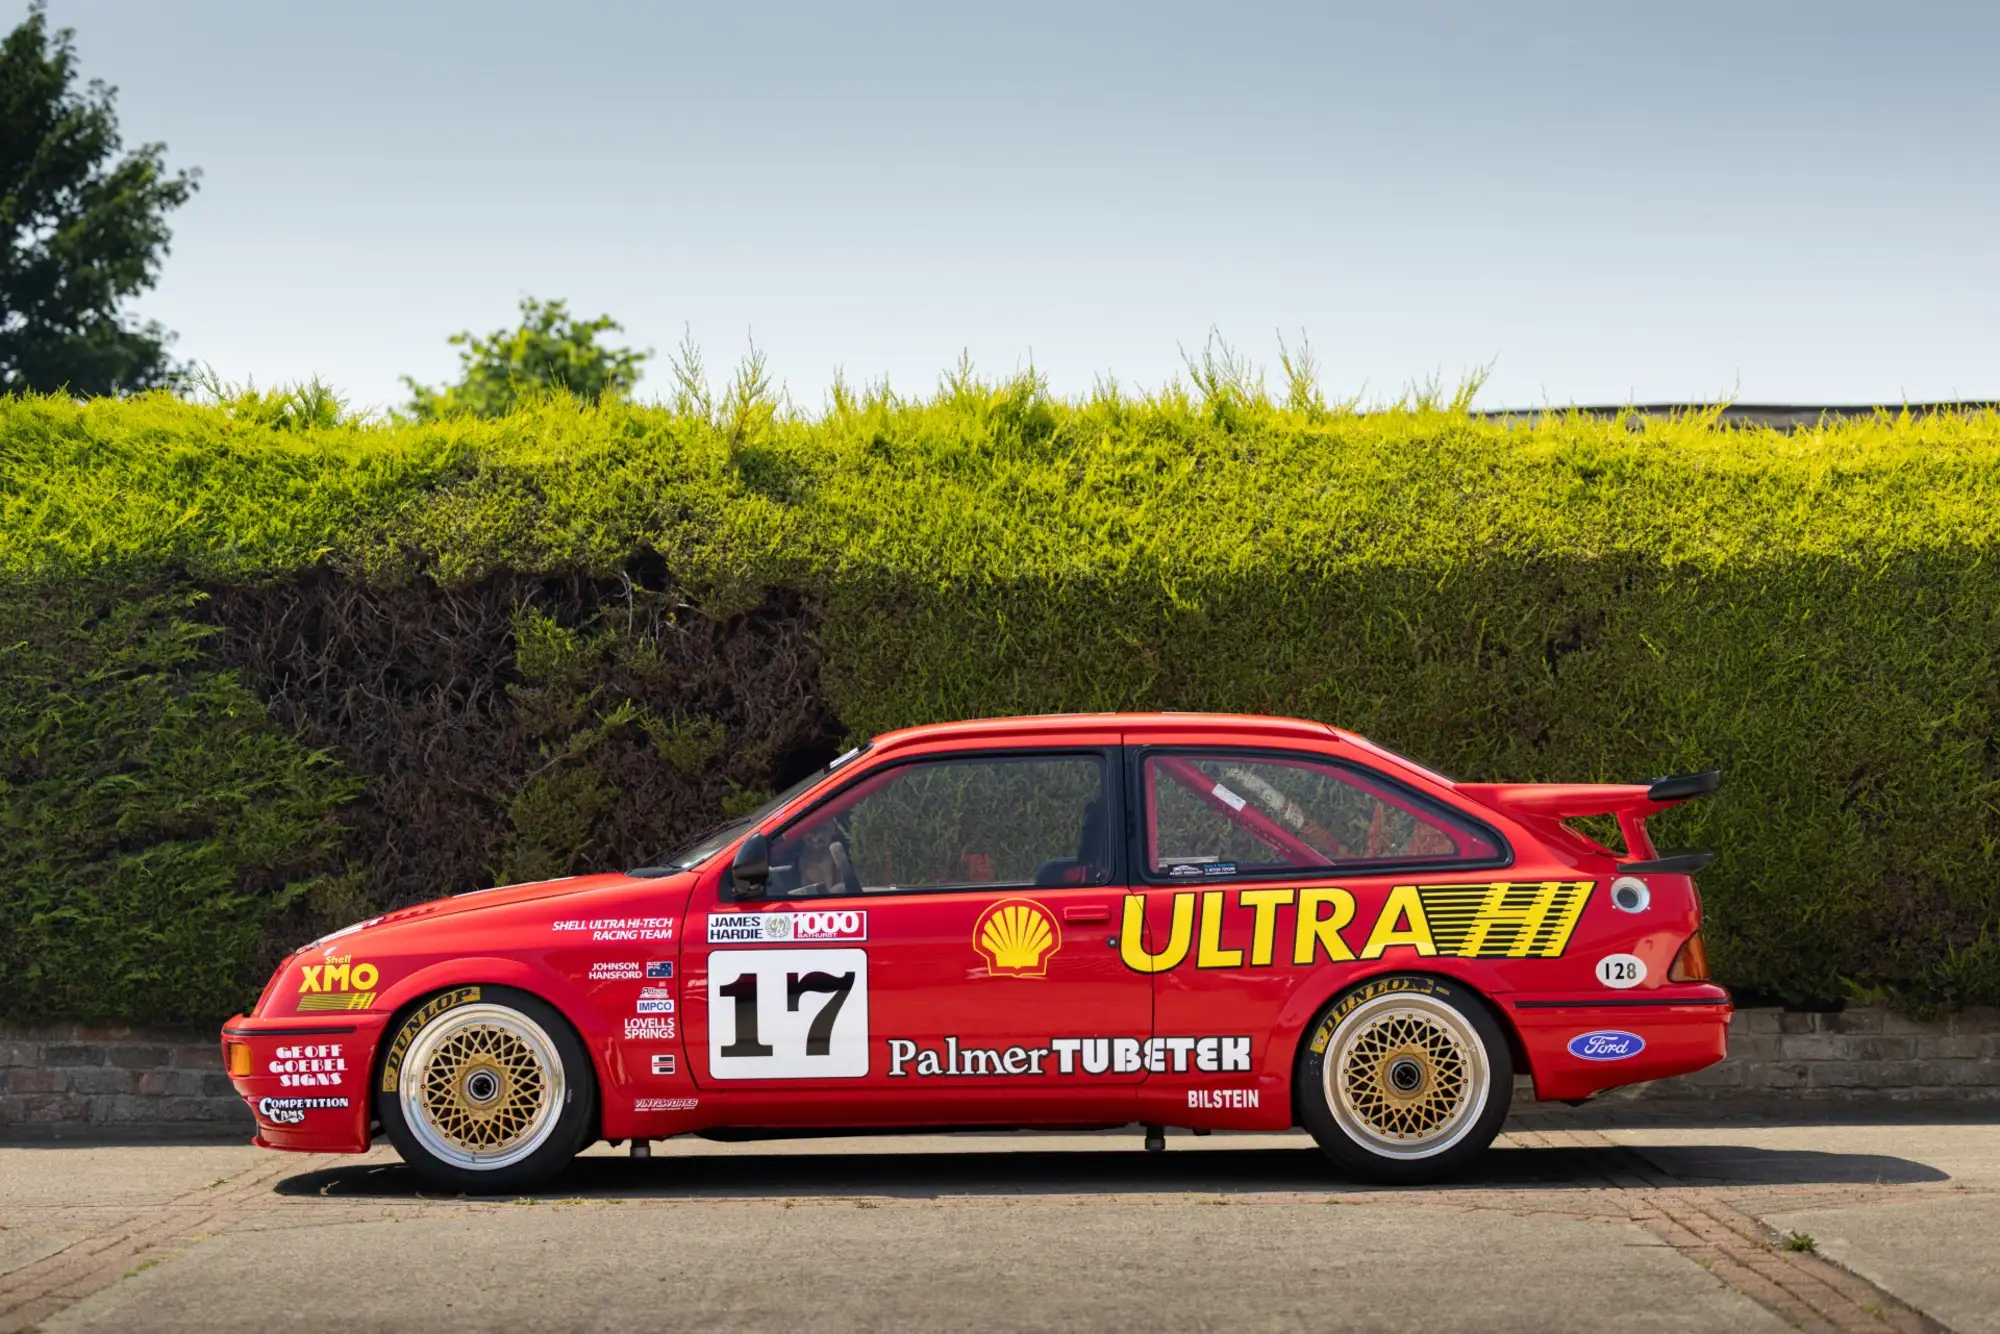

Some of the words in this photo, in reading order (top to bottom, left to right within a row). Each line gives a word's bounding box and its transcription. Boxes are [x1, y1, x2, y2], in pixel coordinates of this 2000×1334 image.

[552, 920, 586, 931] SHELL
[589, 919, 625, 930] ULTRA
[627, 917, 673, 929] HI-TECH
[711, 916, 761, 928] JAMES
[793, 912, 859, 933] 1000
[1119, 884, 1438, 973] ULTRA
[592, 930, 638, 941] RACING
[640, 929, 673, 939] TEAM
[710, 928, 763, 940] HARDIE
[325, 955, 351, 964] Shell
[592, 962, 639, 972] JOHNSON
[1605, 963, 1637, 980] 128
[298, 963, 379, 992] XMO
[588, 970, 643, 980] HANSFORD
[639, 1002, 672, 1011] IMPCO
[719, 971, 856, 1058] 17
[387, 987, 473, 1073] DUNLOP
[624, 1017, 675, 1029] LOVELLS
[624, 1028, 675, 1039] SPRINGS
[276, 1044, 343, 1059] GEOFF
[1584, 1035, 1629, 1055] Ford
[887, 1036, 1048, 1078] Palmer
[1050, 1036, 1253, 1075] TUBETEK
[269, 1059, 348, 1073] GOEBEL
[280, 1073, 343, 1087] SIGNS
[1187, 1089, 1259, 1108] BILSTEIN
